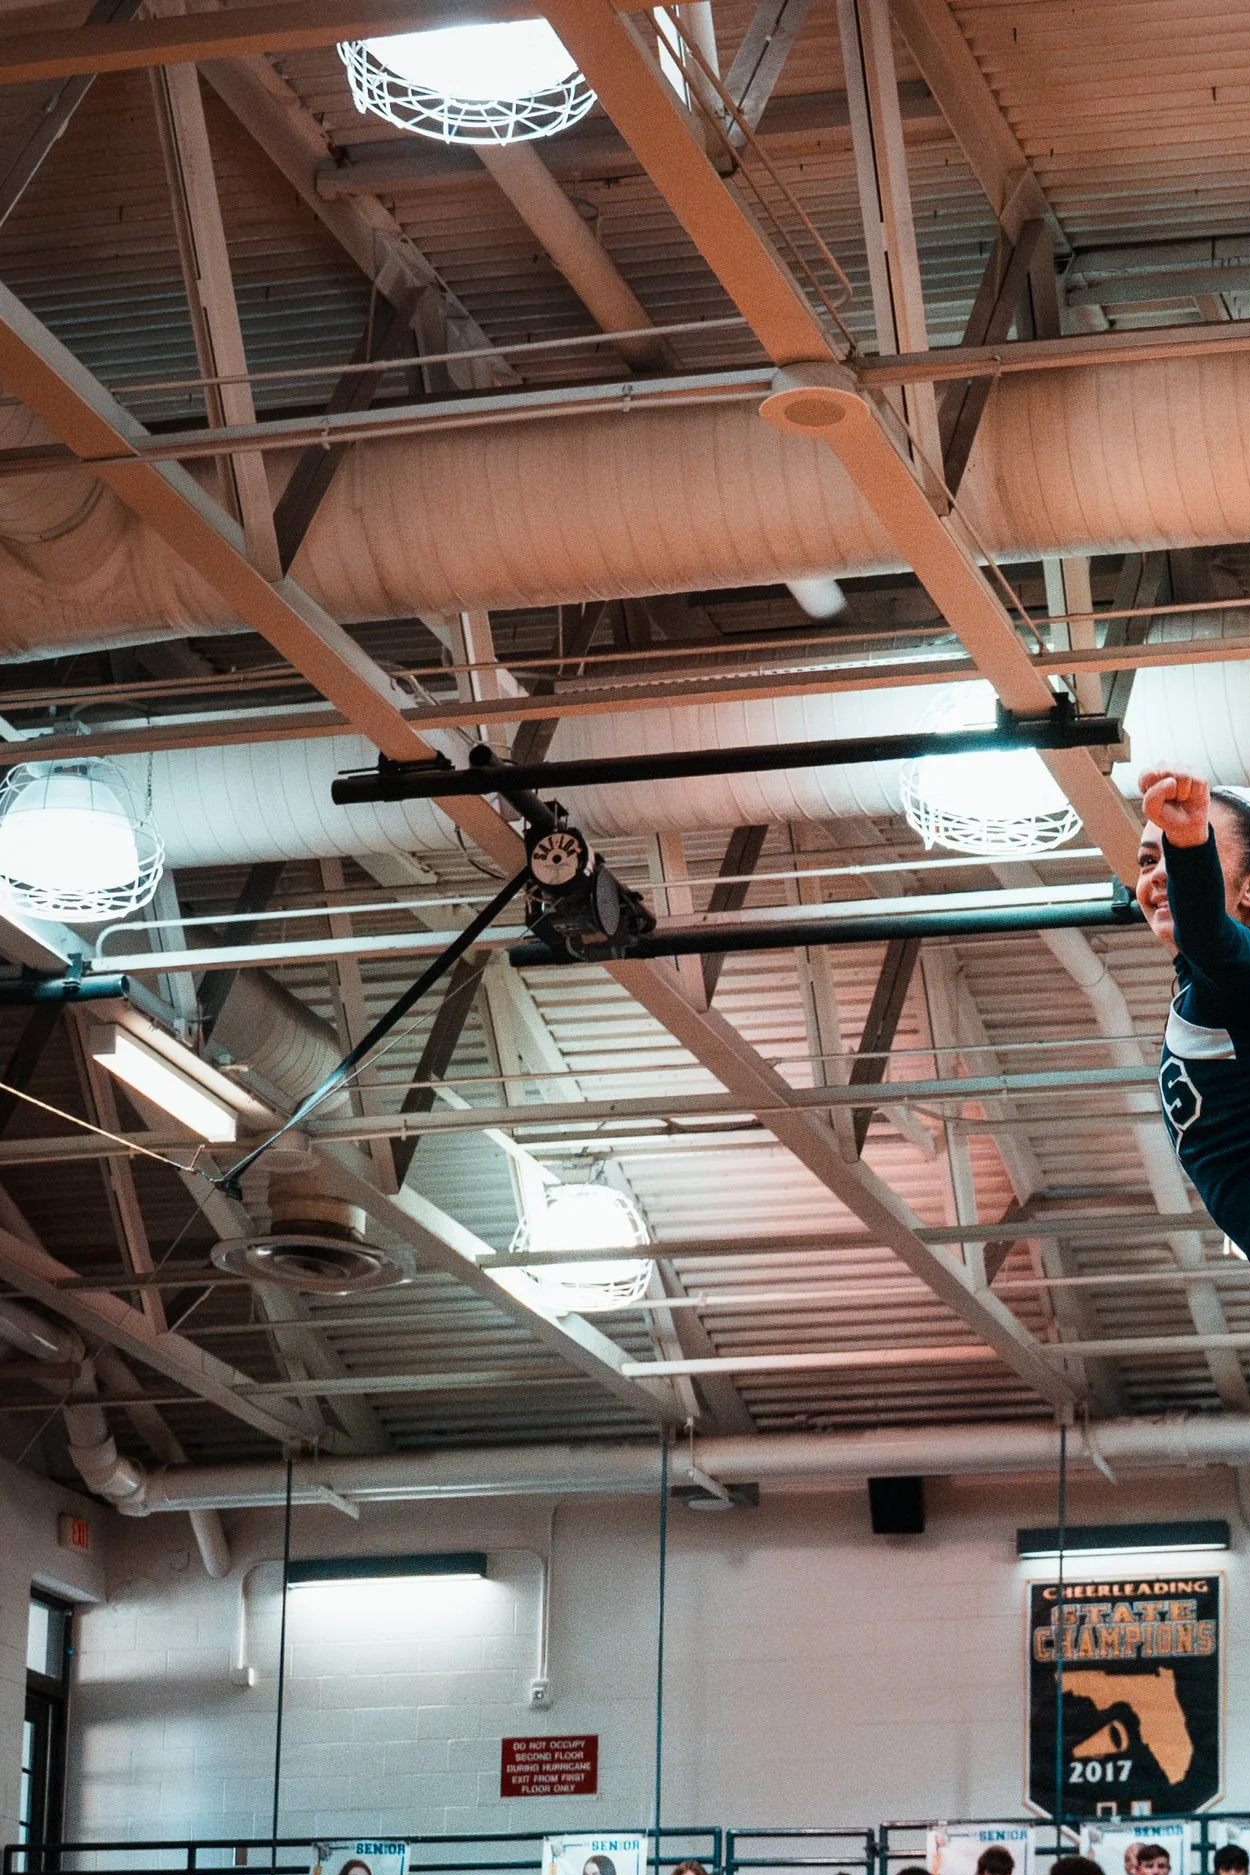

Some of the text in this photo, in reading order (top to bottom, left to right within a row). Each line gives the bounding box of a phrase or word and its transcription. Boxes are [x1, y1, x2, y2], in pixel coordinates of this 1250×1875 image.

[1042, 1580, 1208, 1600] CHEERLEADING
[1051, 1599, 1198, 1625] STATE
[1033, 1619, 1217, 1662] CHAMPIONS
[512, 1739, 586, 1751] DO NOT OCCUPY
[515, 1750, 585, 1762] SECOND FLOOR
[506, 1761, 591, 1773] DURING HURRICANE
[1069, 1760, 1132, 1783] 2017
[511, 1772, 585, 1785] EXIT FROM FIRST
[521, 1783, 576, 1794] FLOOR ONLY
[356, 1843, 405, 1855] SENIOR
[591, 1840, 639, 1851] SENIOR
